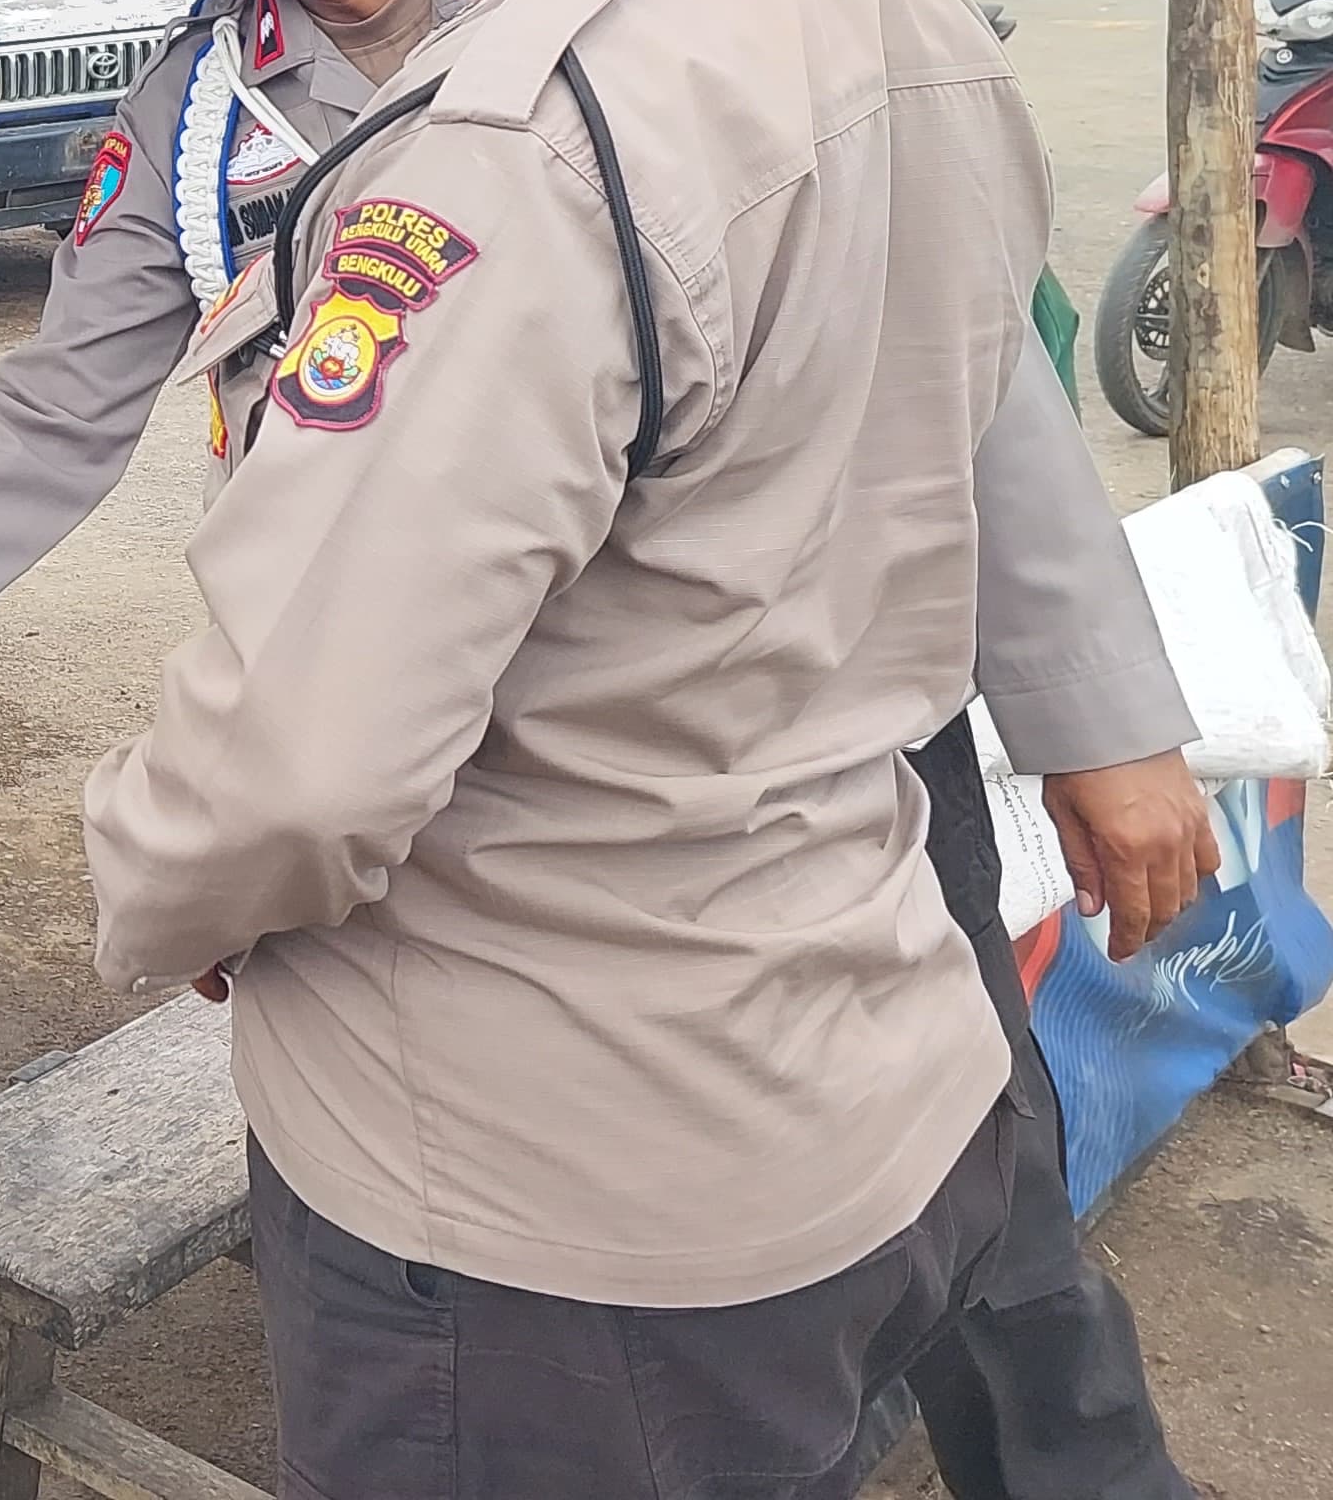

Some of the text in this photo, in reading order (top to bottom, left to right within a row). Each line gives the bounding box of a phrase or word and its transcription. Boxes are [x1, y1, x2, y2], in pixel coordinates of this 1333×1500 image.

[340, 221, 449, 276] BENGKULU UTARA
[359, 203, 450, 250] POLRES
[337, 254, 423, 298] BENGKULU
